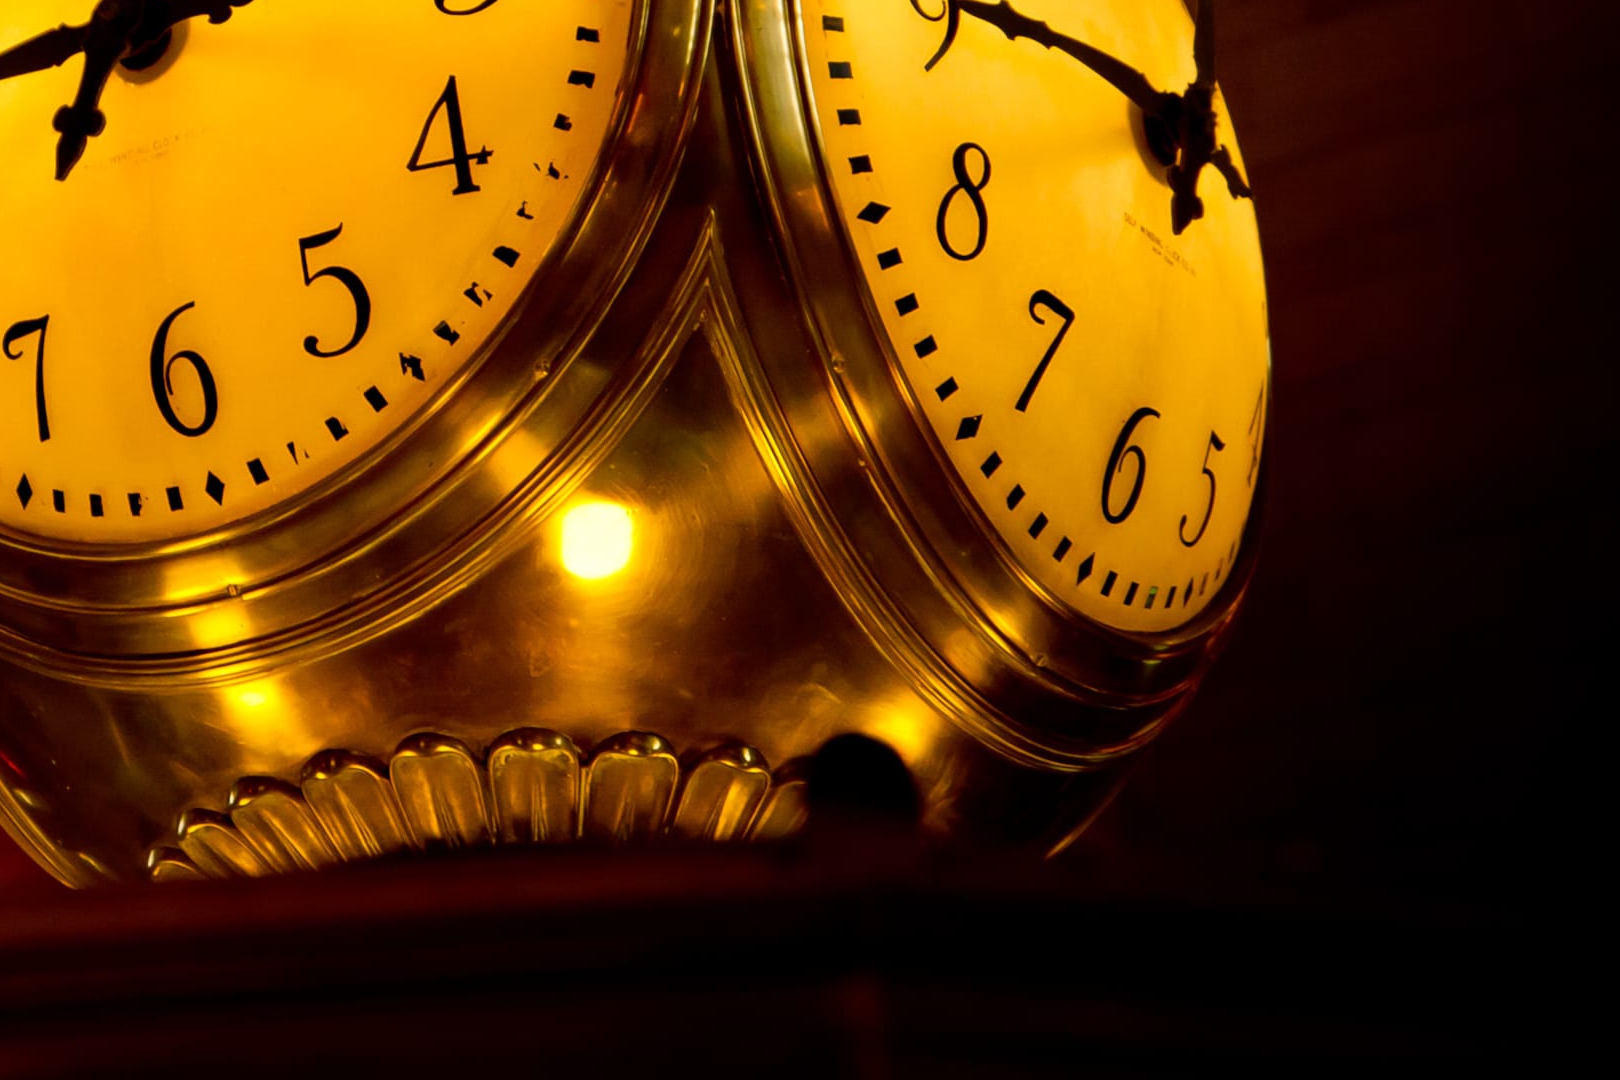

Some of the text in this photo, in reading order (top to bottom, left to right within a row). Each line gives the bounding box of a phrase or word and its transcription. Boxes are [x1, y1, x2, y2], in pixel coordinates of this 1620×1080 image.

[406, 75, 494, 196] 4
[936, 142, 992, 261] 8
[298, 222, 372, 358] 5
[1014, 289, 1076, 413] 7
[1, 314, 51, 442] 7
[149, 301, 219, 437] 6
[1100, 407, 1161, 525] 6
[1179, 430, 1226, 547] 5
